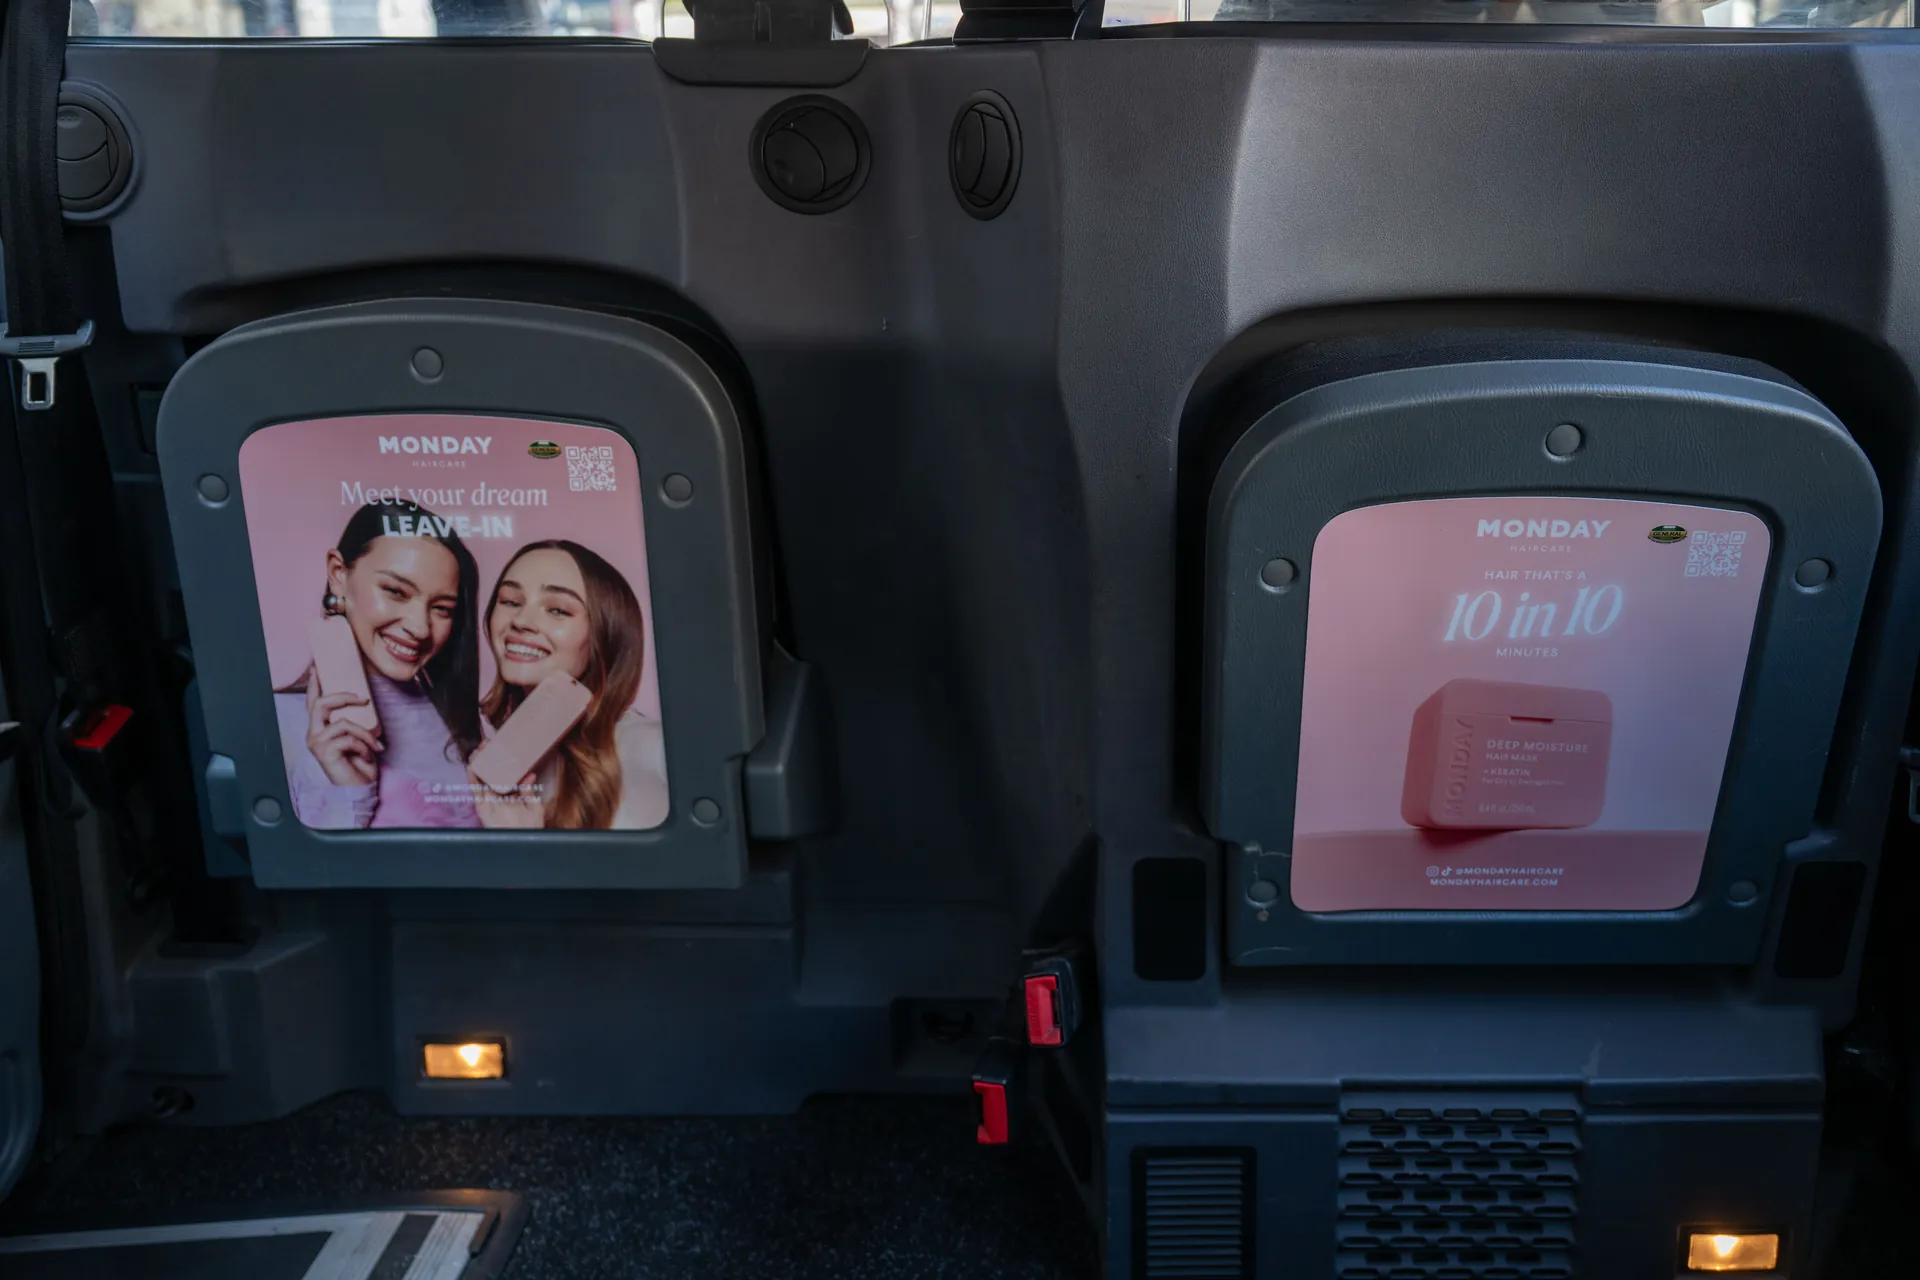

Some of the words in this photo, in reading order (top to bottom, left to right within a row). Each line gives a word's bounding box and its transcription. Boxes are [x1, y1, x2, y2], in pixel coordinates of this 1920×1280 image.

[378, 436, 493, 455] MONDAY
[412, 460, 467, 469] HAIRCARE
[340, 481, 403, 507] Meet
[406, 485, 466, 512] your
[471, 482, 548, 507] dream
[382, 515, 514, 538] LEAVE-IN
[1476, 518, 1612, 539] MONDAY
[1510, 544, 1573, 553] HAIRCARE
[1484, 570, 1519, 580] HAIR
[1524, 569, 1573, 580] THAT'S
[1577, 570, 1587, 580] A
[1443, 590, 1502, 642] 10
[1507, 592, 1558, 640] in
[1562, 583, 1624, 636] 10
[1496, 647, 1559, 658] MINUTES
[1486, 739, 1520, 750] DEEP
[1523, 741, 1590, 754] MOISTURE
[1485, 752, 1509, 761] HAIR
[1511, 753, 1539, 762] MASK
[1490, 768, 1531, 777] KERATIN
[1455, 866, 1565, 876] @MONDAYHAIRCARE
[1430, 878, 1559, 887] MONDAYHAIRCARE.COM
